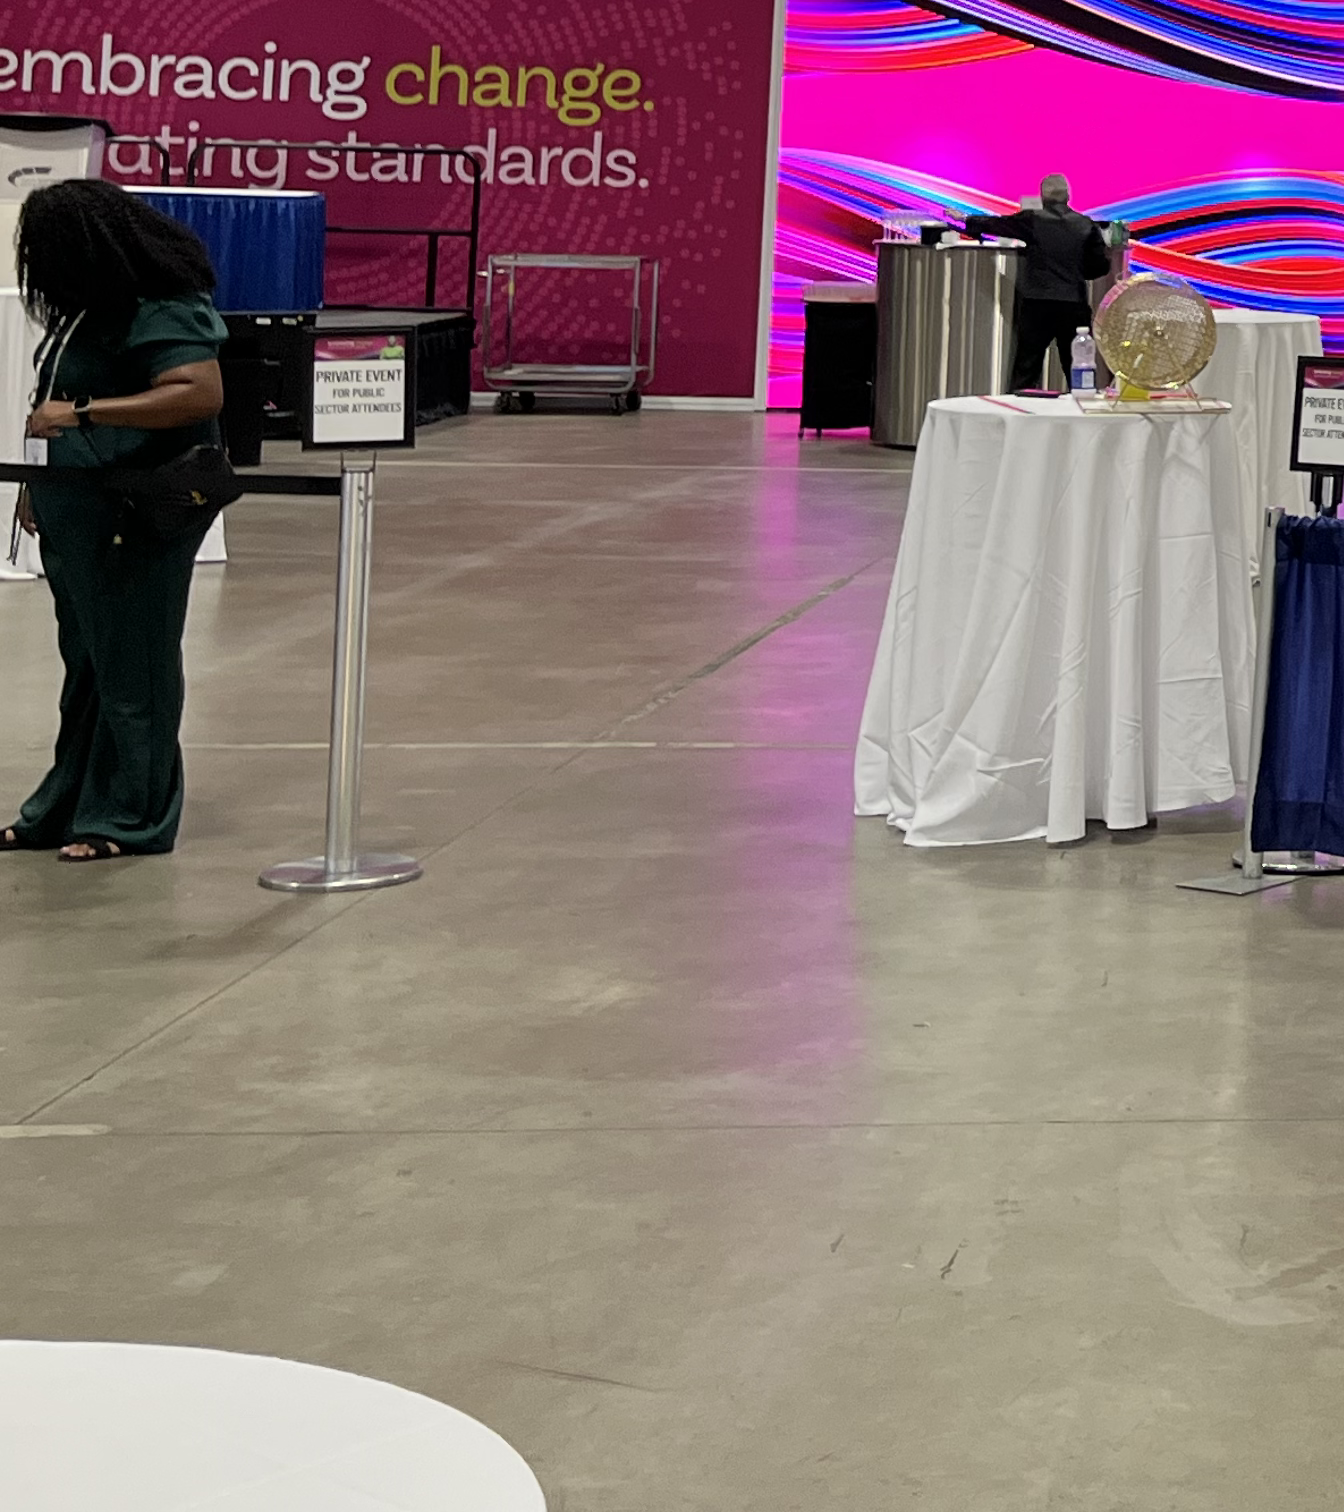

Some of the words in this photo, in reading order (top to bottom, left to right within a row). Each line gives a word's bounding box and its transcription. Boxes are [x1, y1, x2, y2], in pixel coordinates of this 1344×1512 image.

[385, 45, 654, 126] change.
[305, 128, 649, 188] standards.
[316, 370, 362, 383] PRIVATE
[366, 369, 402, 382] EVENT
[333, 388, 350, 398] FOR
[352, 388, 385, 398] PUBLIC
[314, 404, 350, 414] SECTOR
[1304, 396, 1336, 409] PRIVATE
